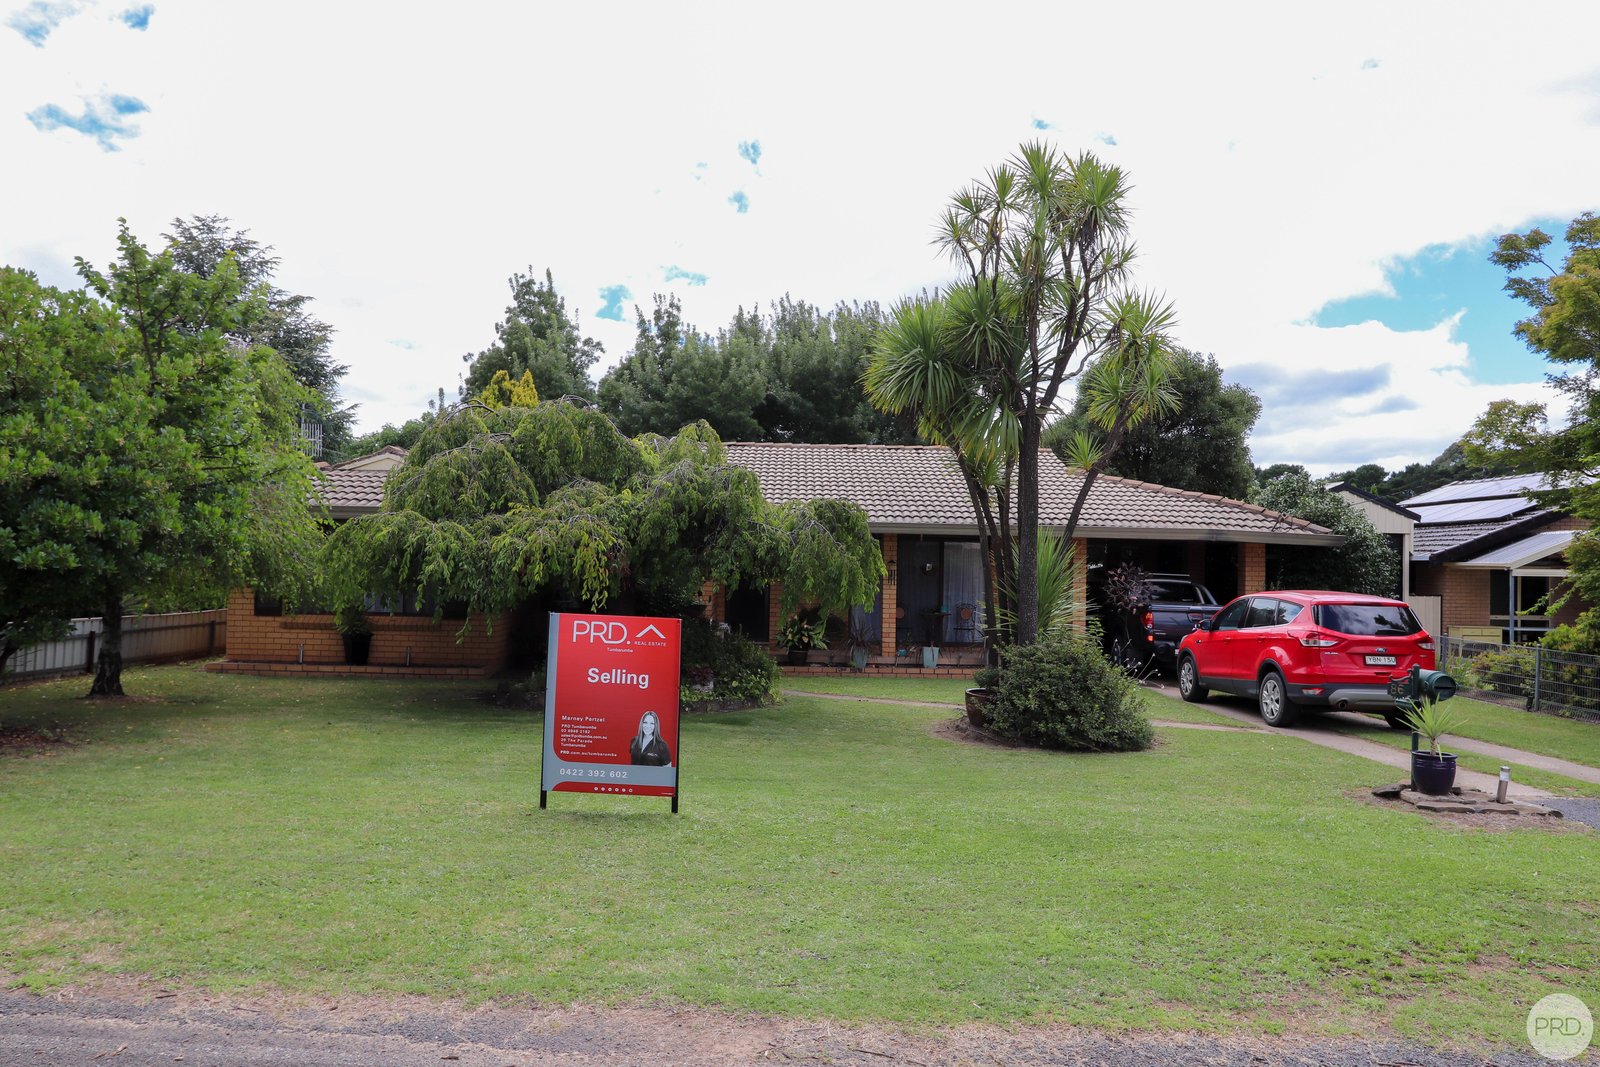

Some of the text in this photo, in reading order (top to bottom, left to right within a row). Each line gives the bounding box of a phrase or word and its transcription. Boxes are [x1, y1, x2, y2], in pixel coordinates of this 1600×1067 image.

[587, 667, 649, 689] Selling
[1390, 683, 1404, 695] 86
[560, 768, 628, 779] 0422 392 602
